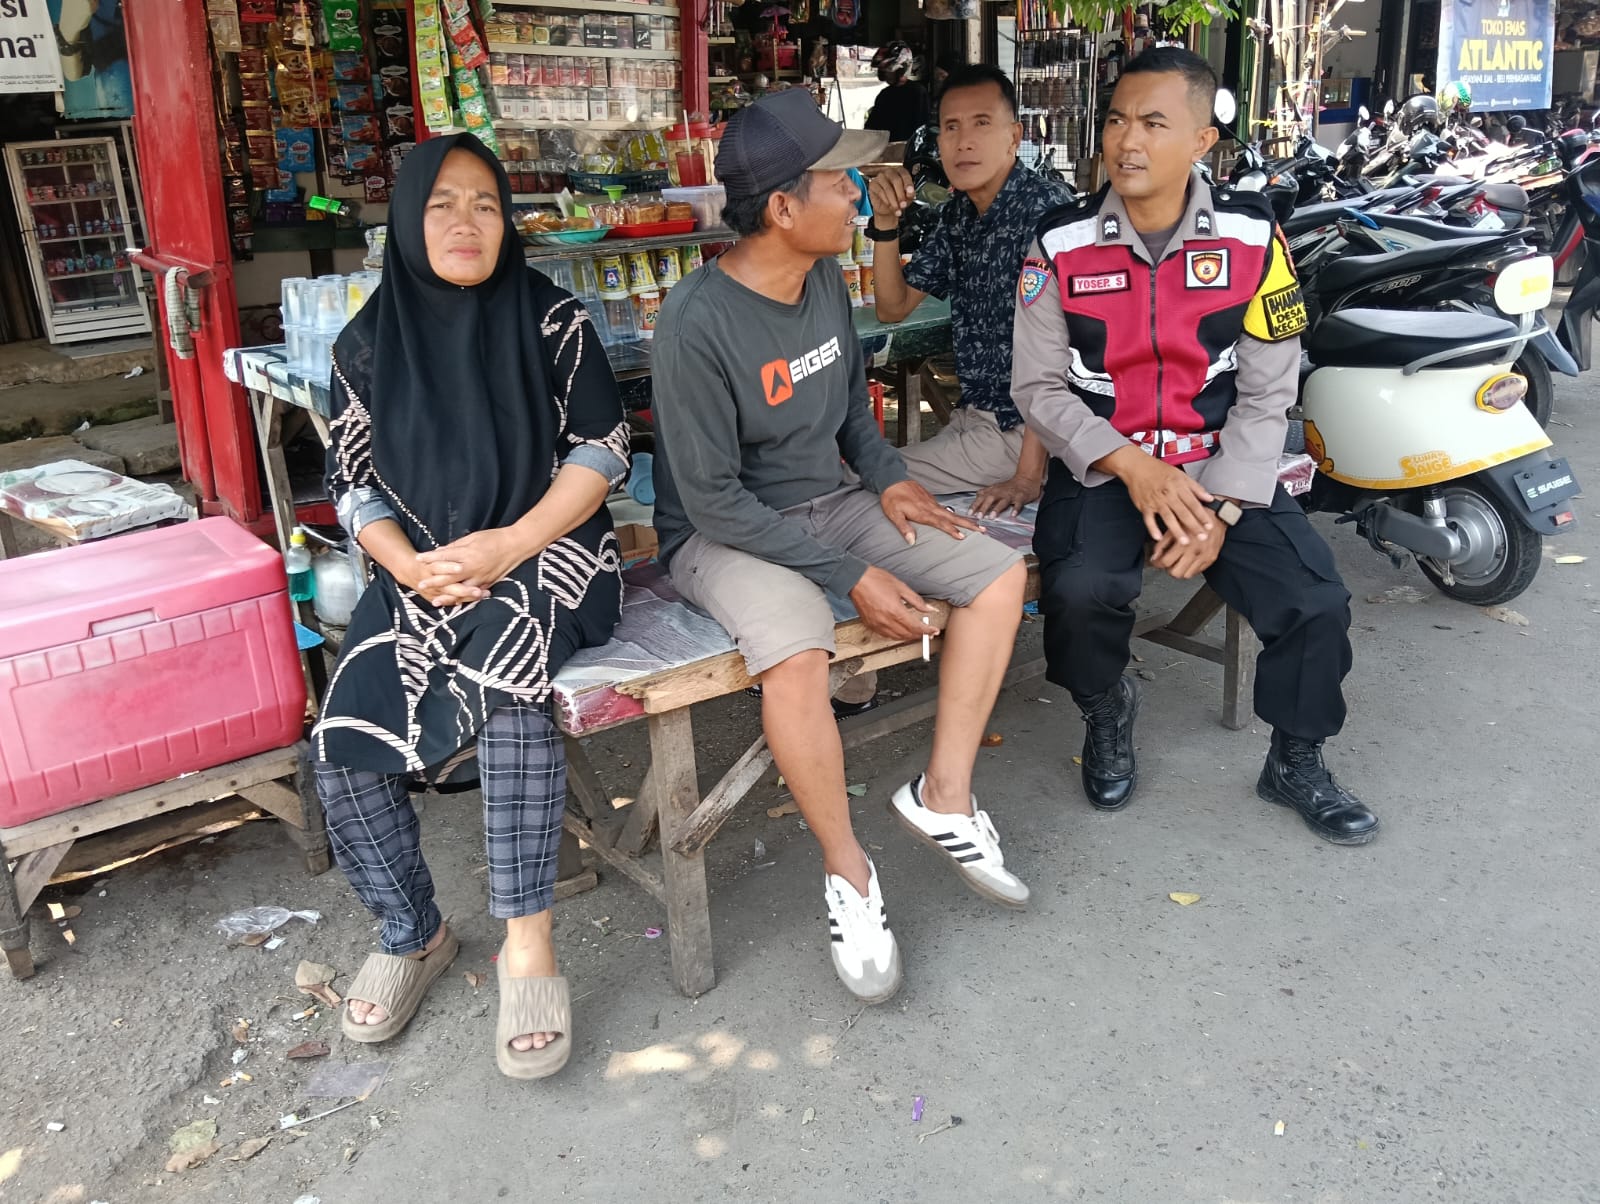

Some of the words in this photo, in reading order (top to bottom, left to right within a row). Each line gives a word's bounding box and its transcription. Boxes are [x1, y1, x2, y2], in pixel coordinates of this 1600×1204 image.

[1481, 19, 1503, 35] TOKO
[1504, 20, 1526, 36] EMAS
[1458, 39, 1544, 71] ATLANTIC
[1115, 276, 1123, 286] S
[1276, 306, 1303, 324] DESA
[789, 336, 842, 384] EIGER
